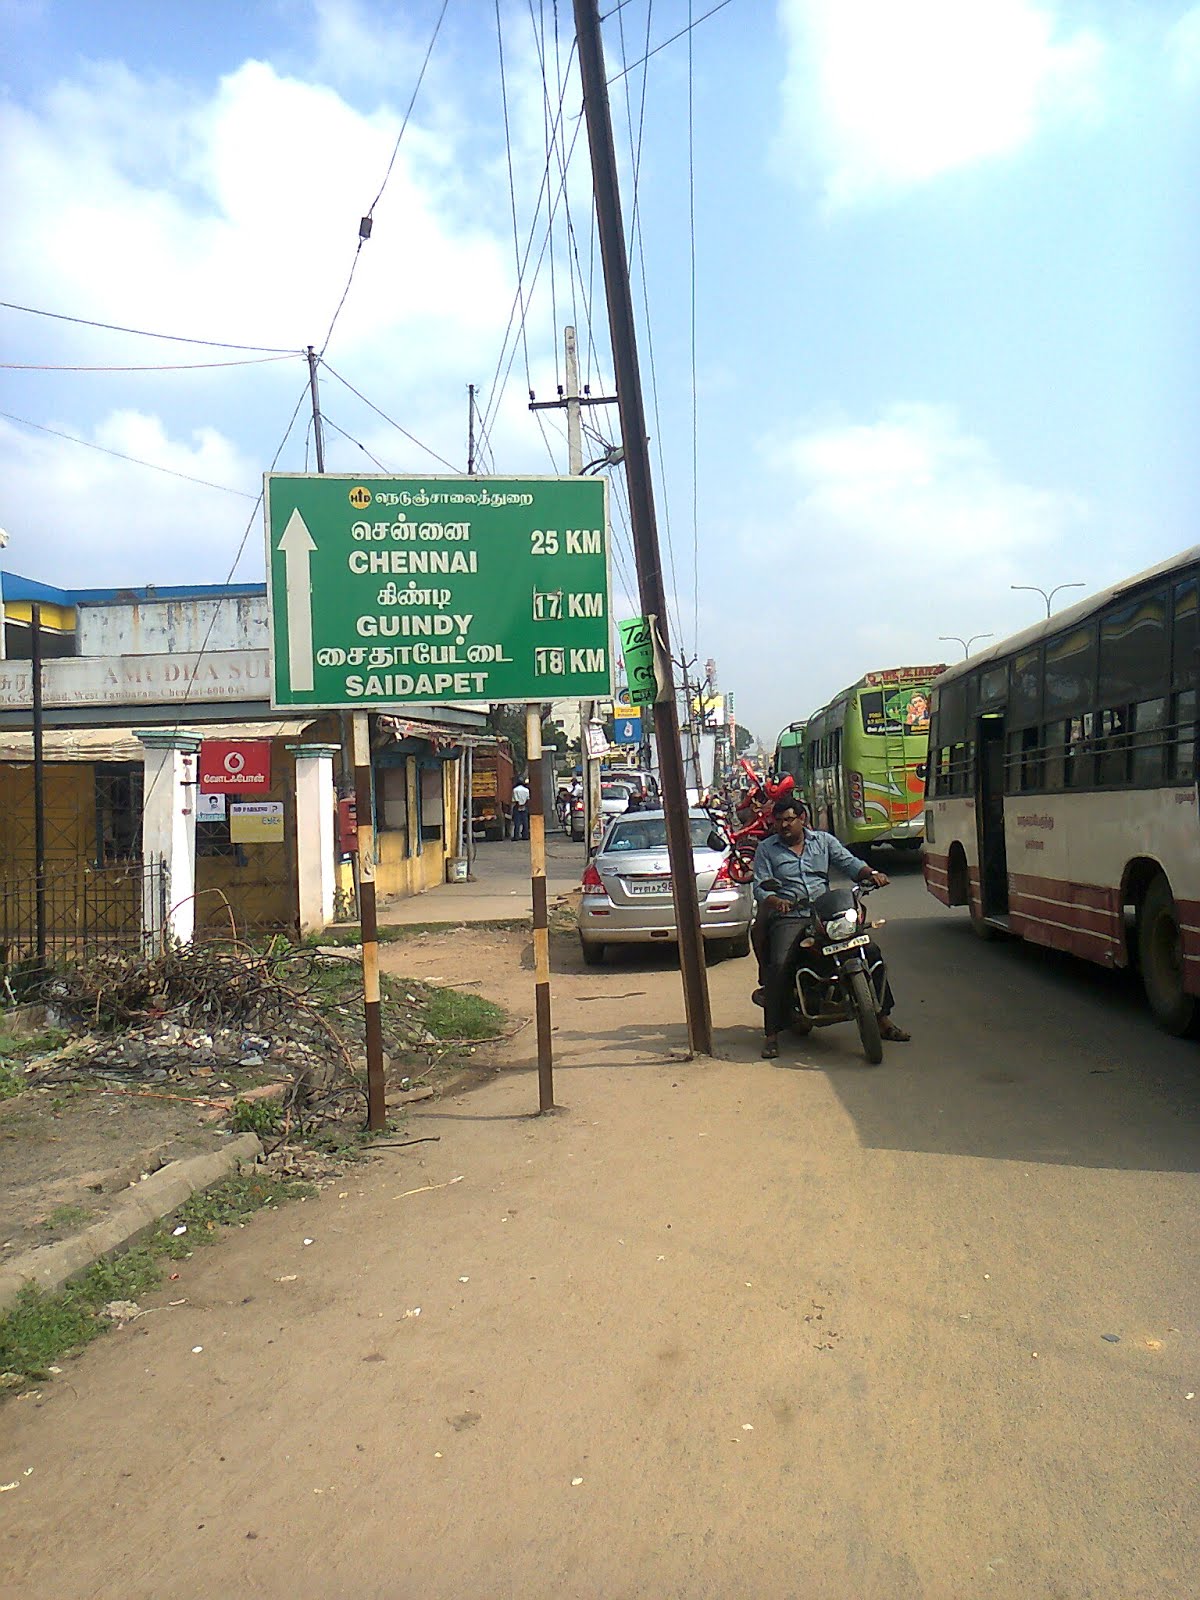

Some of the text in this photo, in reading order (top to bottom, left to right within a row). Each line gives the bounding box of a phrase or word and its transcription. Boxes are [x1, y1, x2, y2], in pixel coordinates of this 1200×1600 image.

[374, 488, 534, 508] நெடுஞ்சாலைத்துறை
[351, 512, 471, 541] சென்னை
[531, 529, 601, 554] 25 KM
[348, 550, 478, 574] CHENNAI
[377, 581, 452, 610] கிண்டி
[534, 592, 603, 618] 17 KM
[356, 614, 473, 637] GUINDY
[316, 636, 514, 671] சைதாபேட்டை
[536, 649, 563, 675] 18
[570, 648, 605, 674] KM
[345, 672, 489, 698] SAIDAPET
